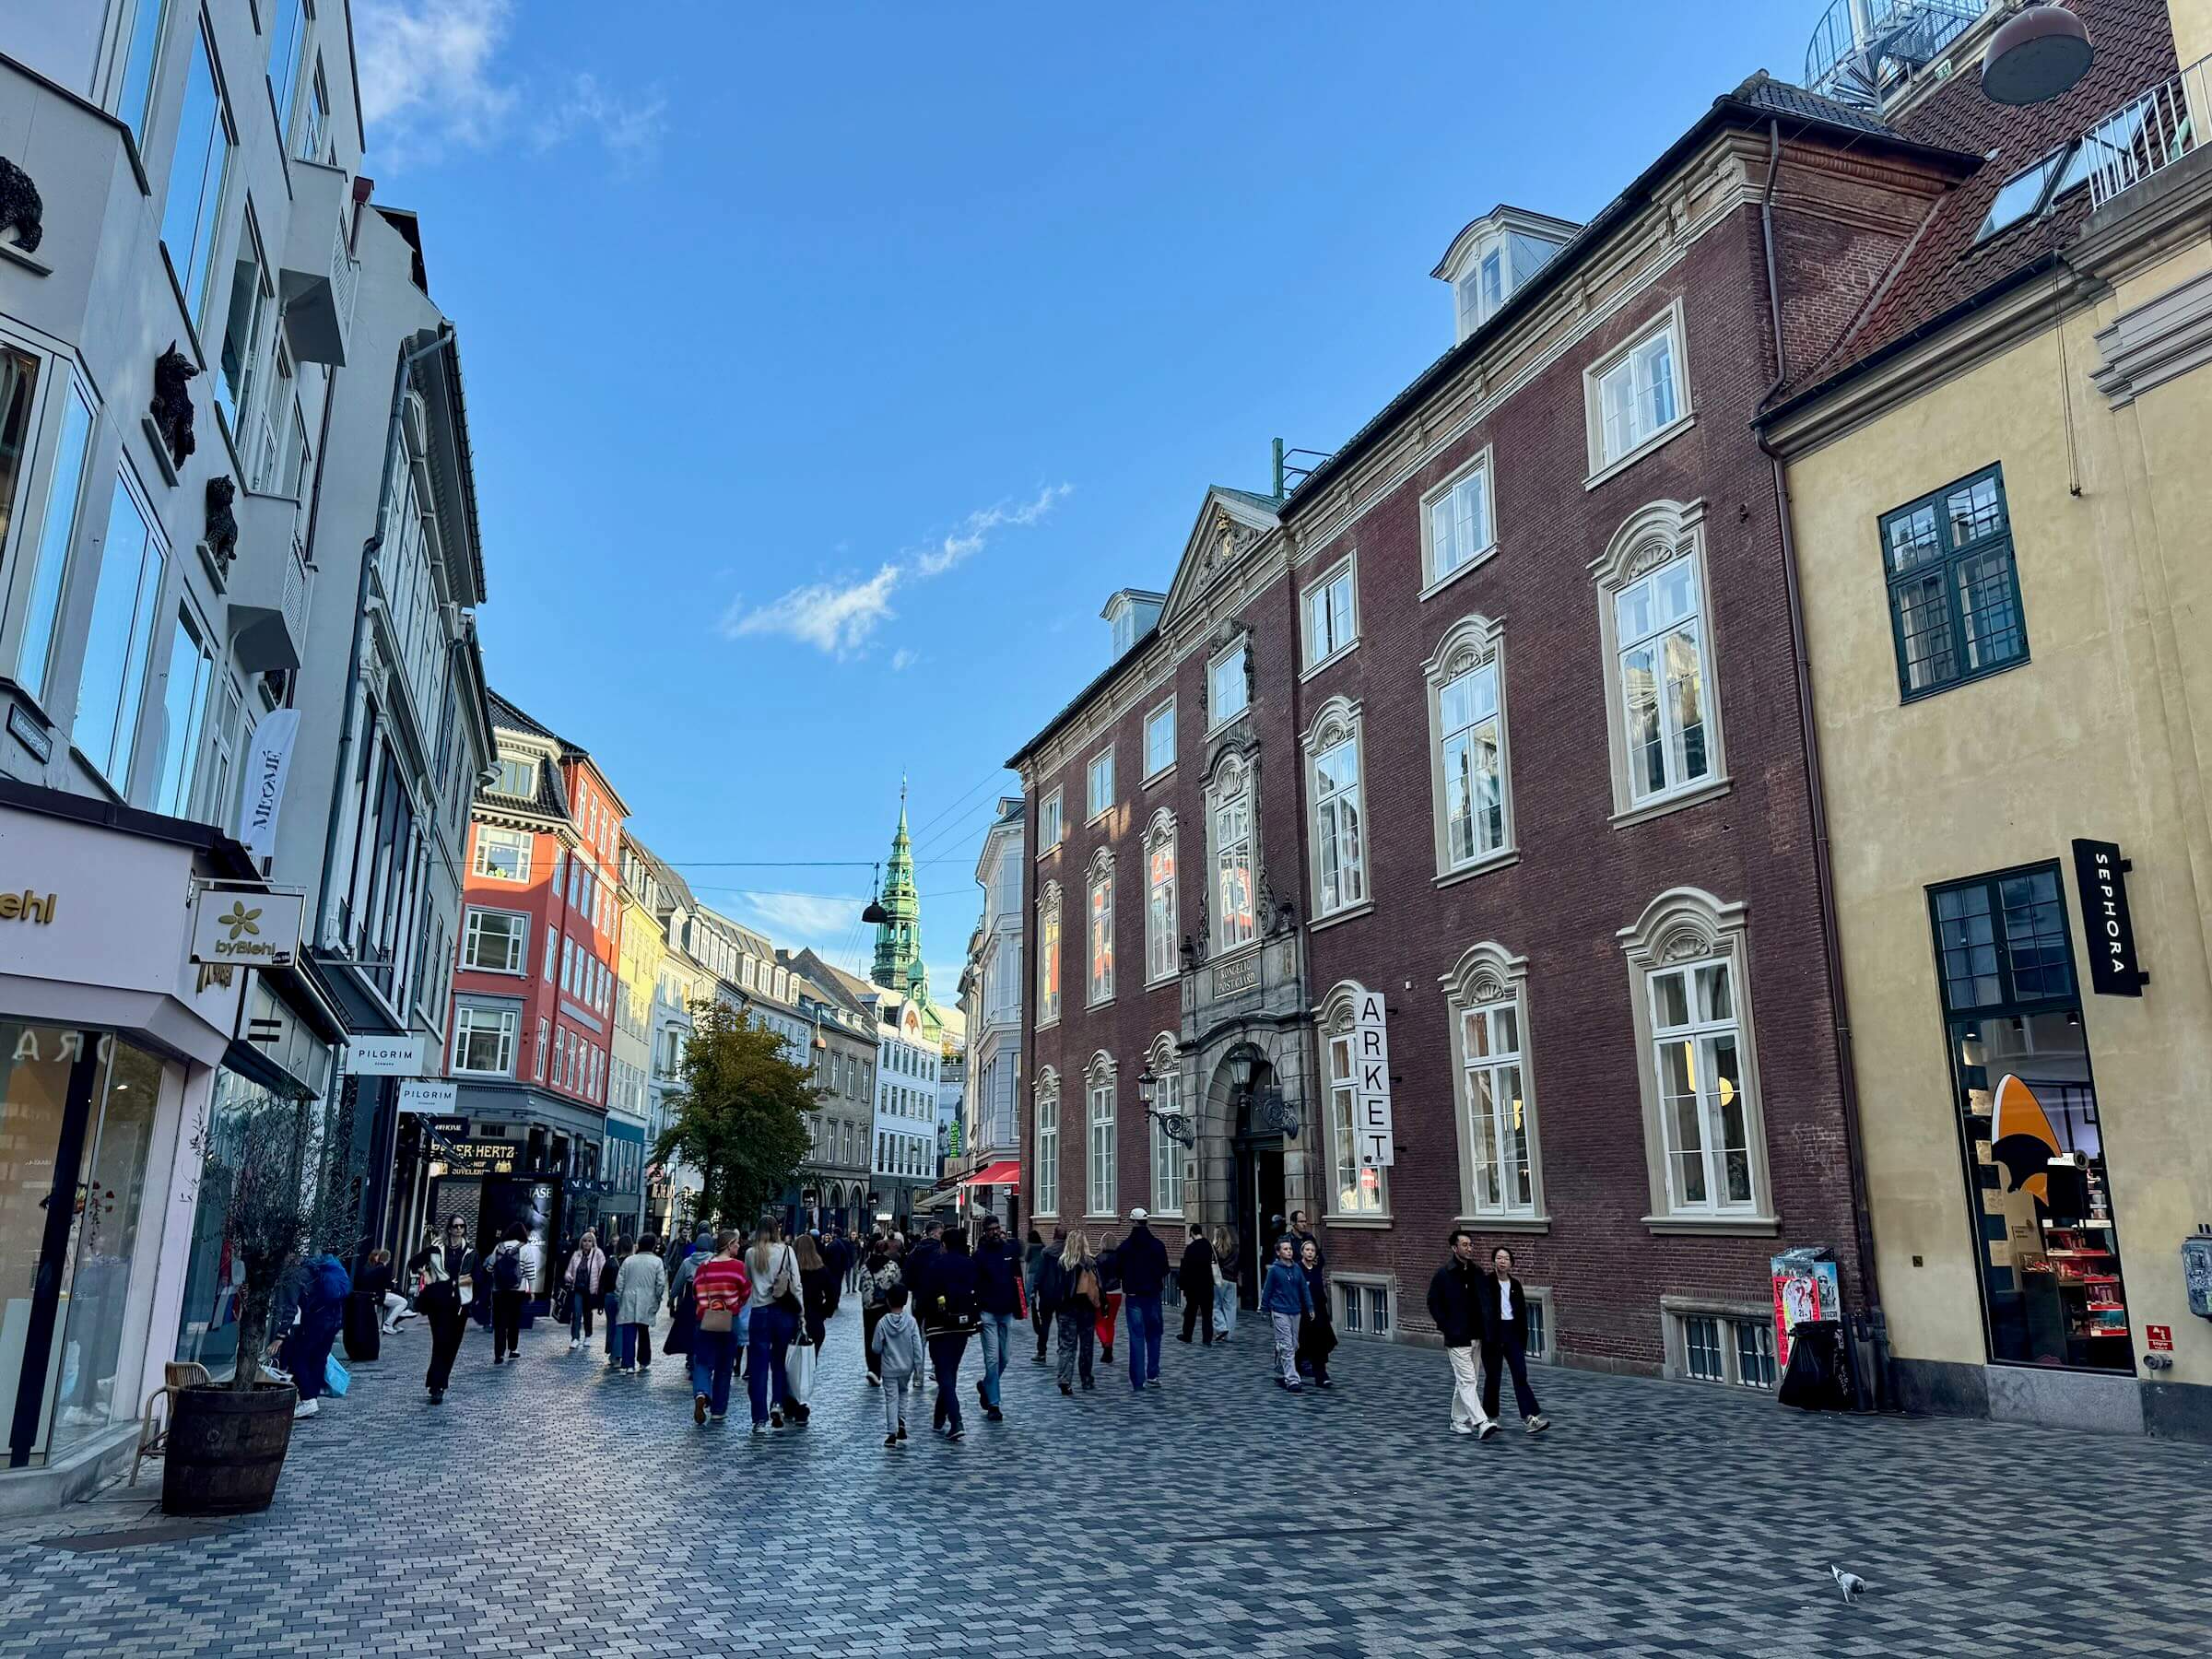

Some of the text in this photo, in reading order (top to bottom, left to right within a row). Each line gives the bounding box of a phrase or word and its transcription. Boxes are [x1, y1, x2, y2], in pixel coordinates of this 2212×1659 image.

[2095, 853, 2124, 972] SEPHORA
[359, 1049, 412, 1059] PILGRIM
[1361, 996, 1387, 1159] ARKET
[404, 1089, 452, 1099] PILGRIM
